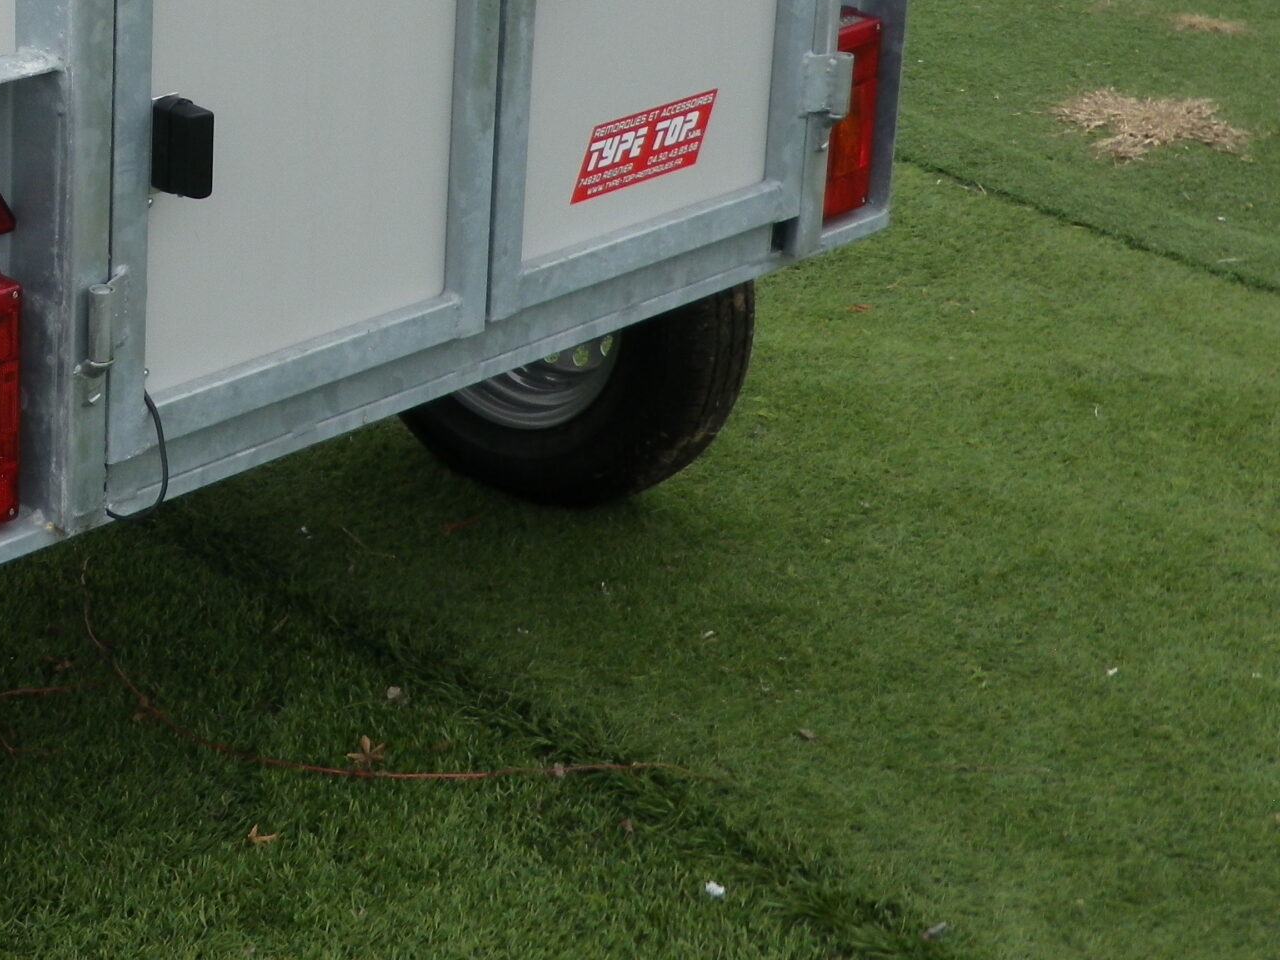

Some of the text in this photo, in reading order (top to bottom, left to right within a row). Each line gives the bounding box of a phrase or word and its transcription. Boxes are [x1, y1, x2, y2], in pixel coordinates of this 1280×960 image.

[586, 126, 649, 172] TYPE
[652, 111, 700, 151] TOP
[594, 93, 714, 138] REMORQUES ET ACCESSOIRES
